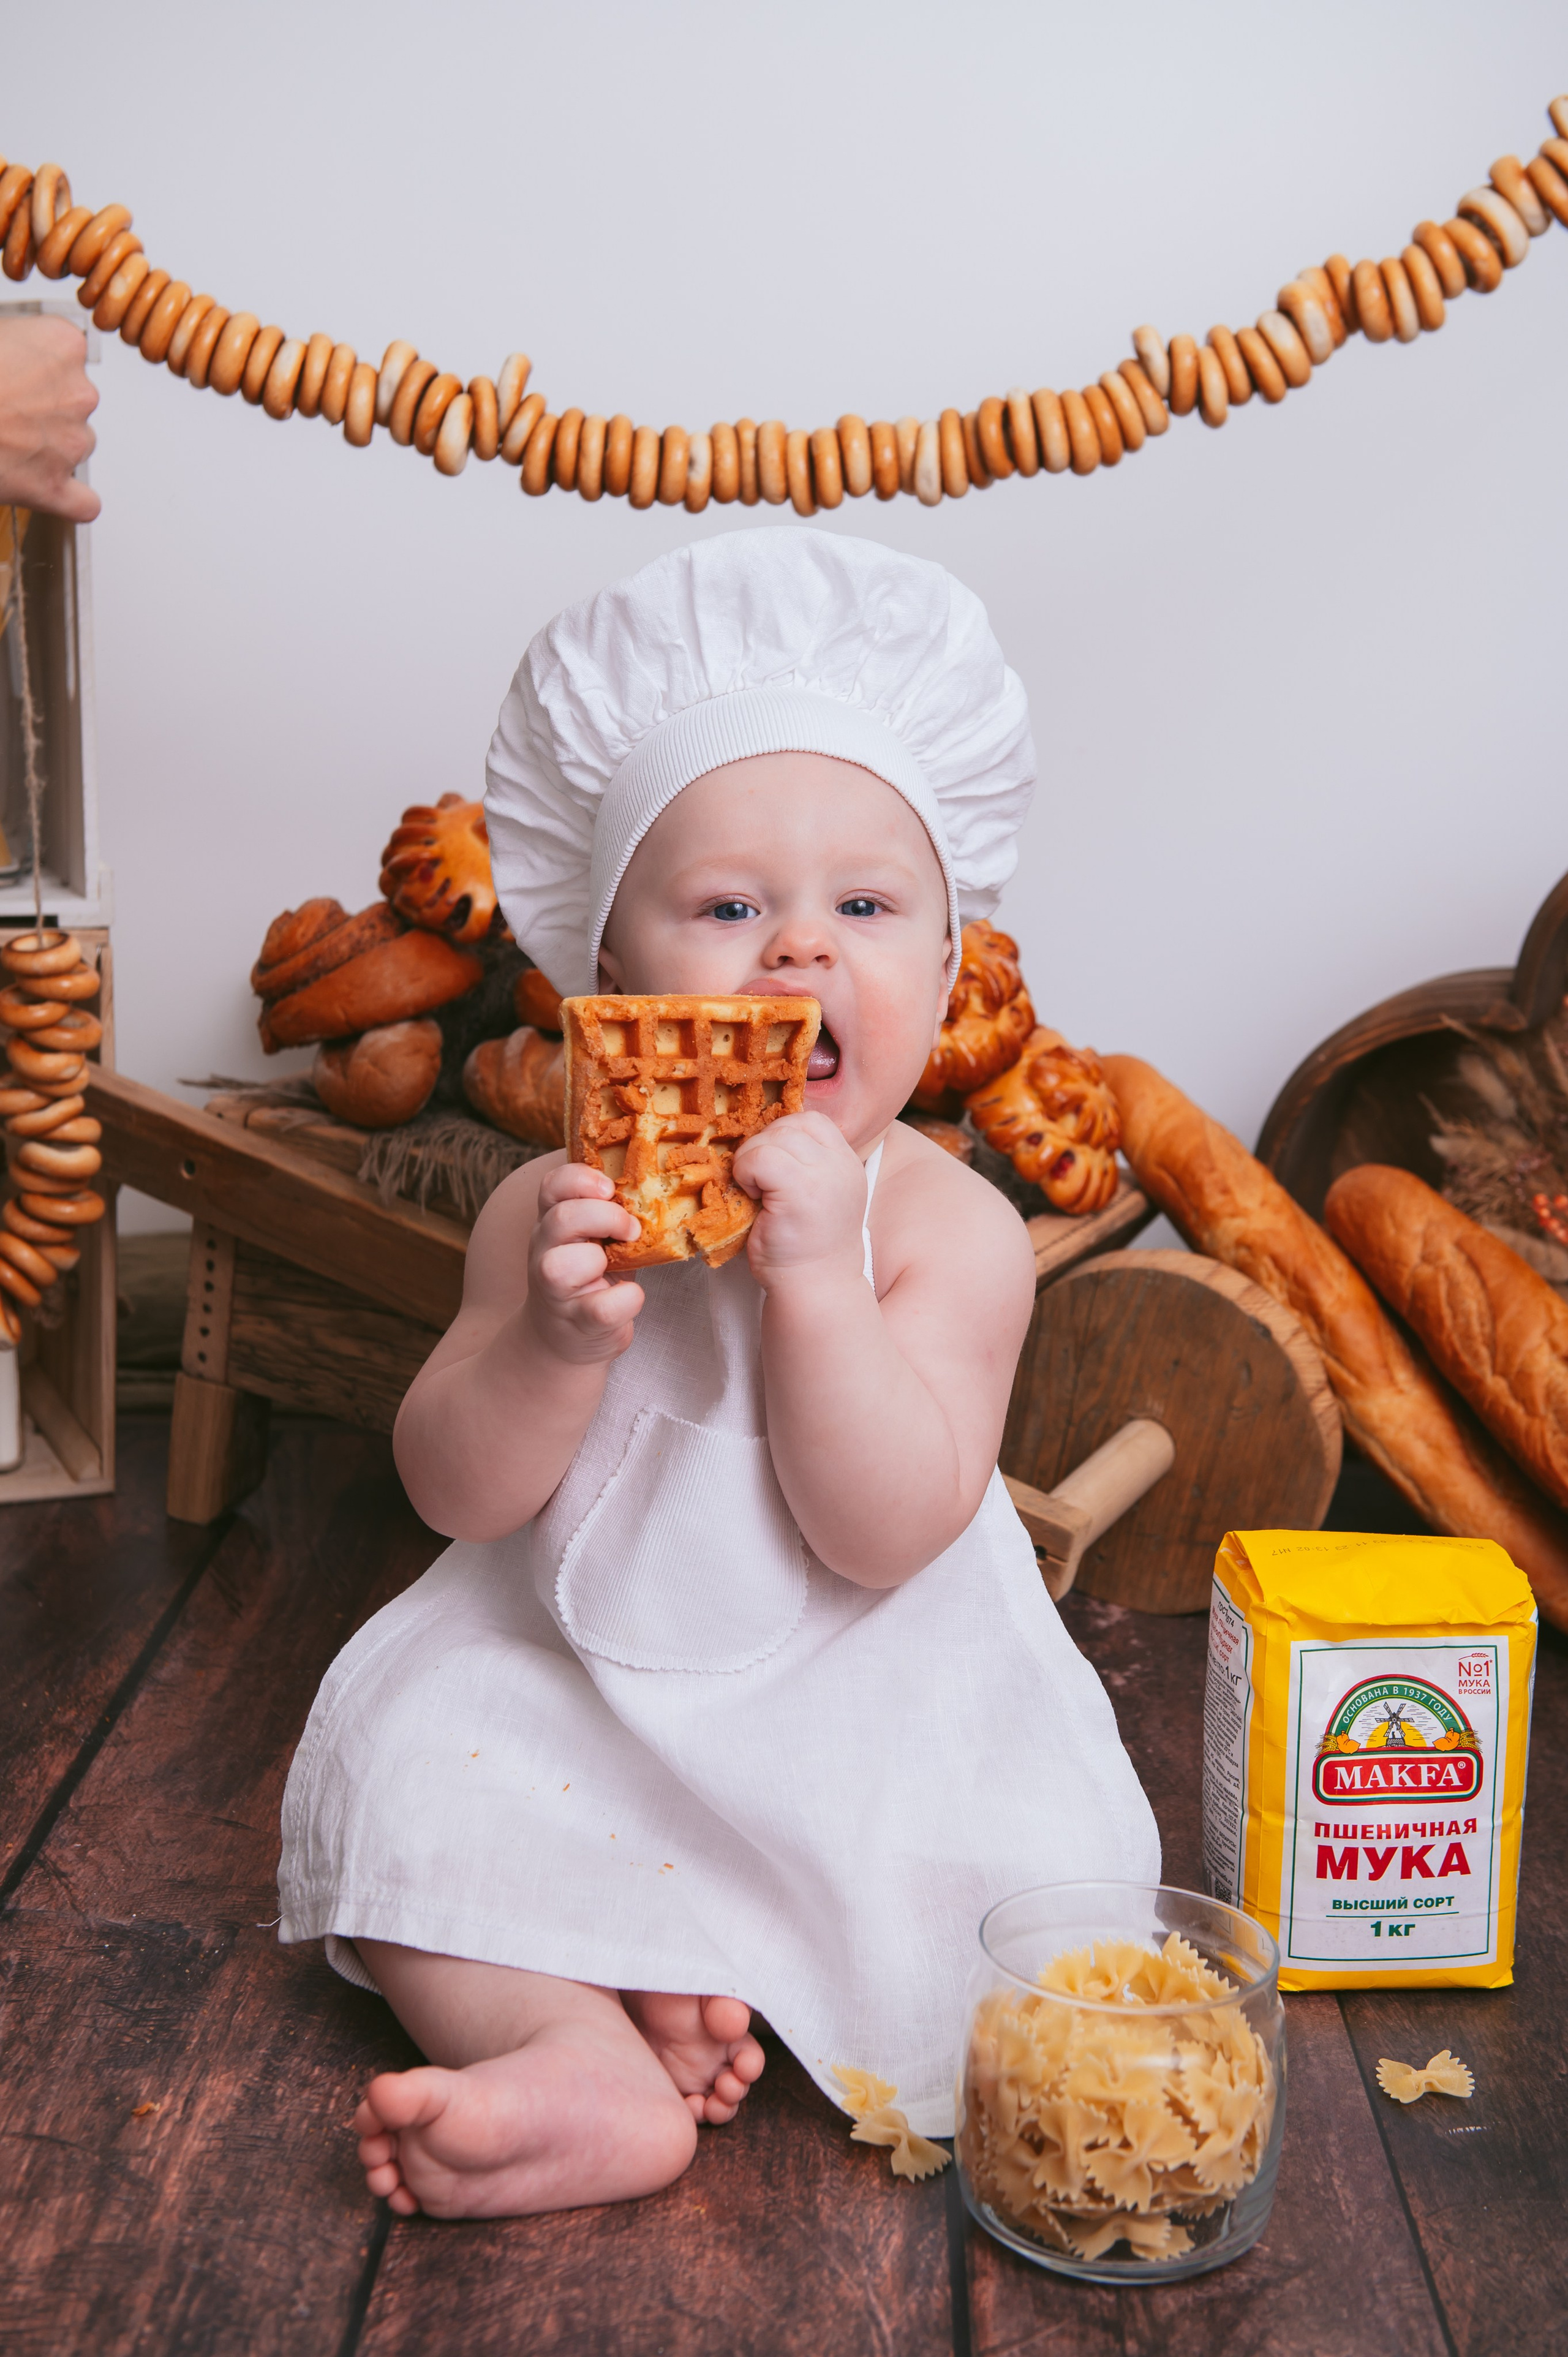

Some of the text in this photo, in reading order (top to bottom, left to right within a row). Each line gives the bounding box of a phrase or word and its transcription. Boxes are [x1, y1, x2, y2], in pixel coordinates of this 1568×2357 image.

[1343, 1686, 1389, 1724] ОСНОВАНА
[1403, 1688, 1427, 1701] 1937
[1428, 1698, 1452, 1721] ГОДУ
[1314, 1818, 1477, 1839] ПШЕНИЧНАЯ
[1316, 1842, 1471, 1881] МУКА
[1332, 1896, 1454, 1910] ВЫСШИЙ СОРТ
[1371, 1921, 1381, 1937] 1
